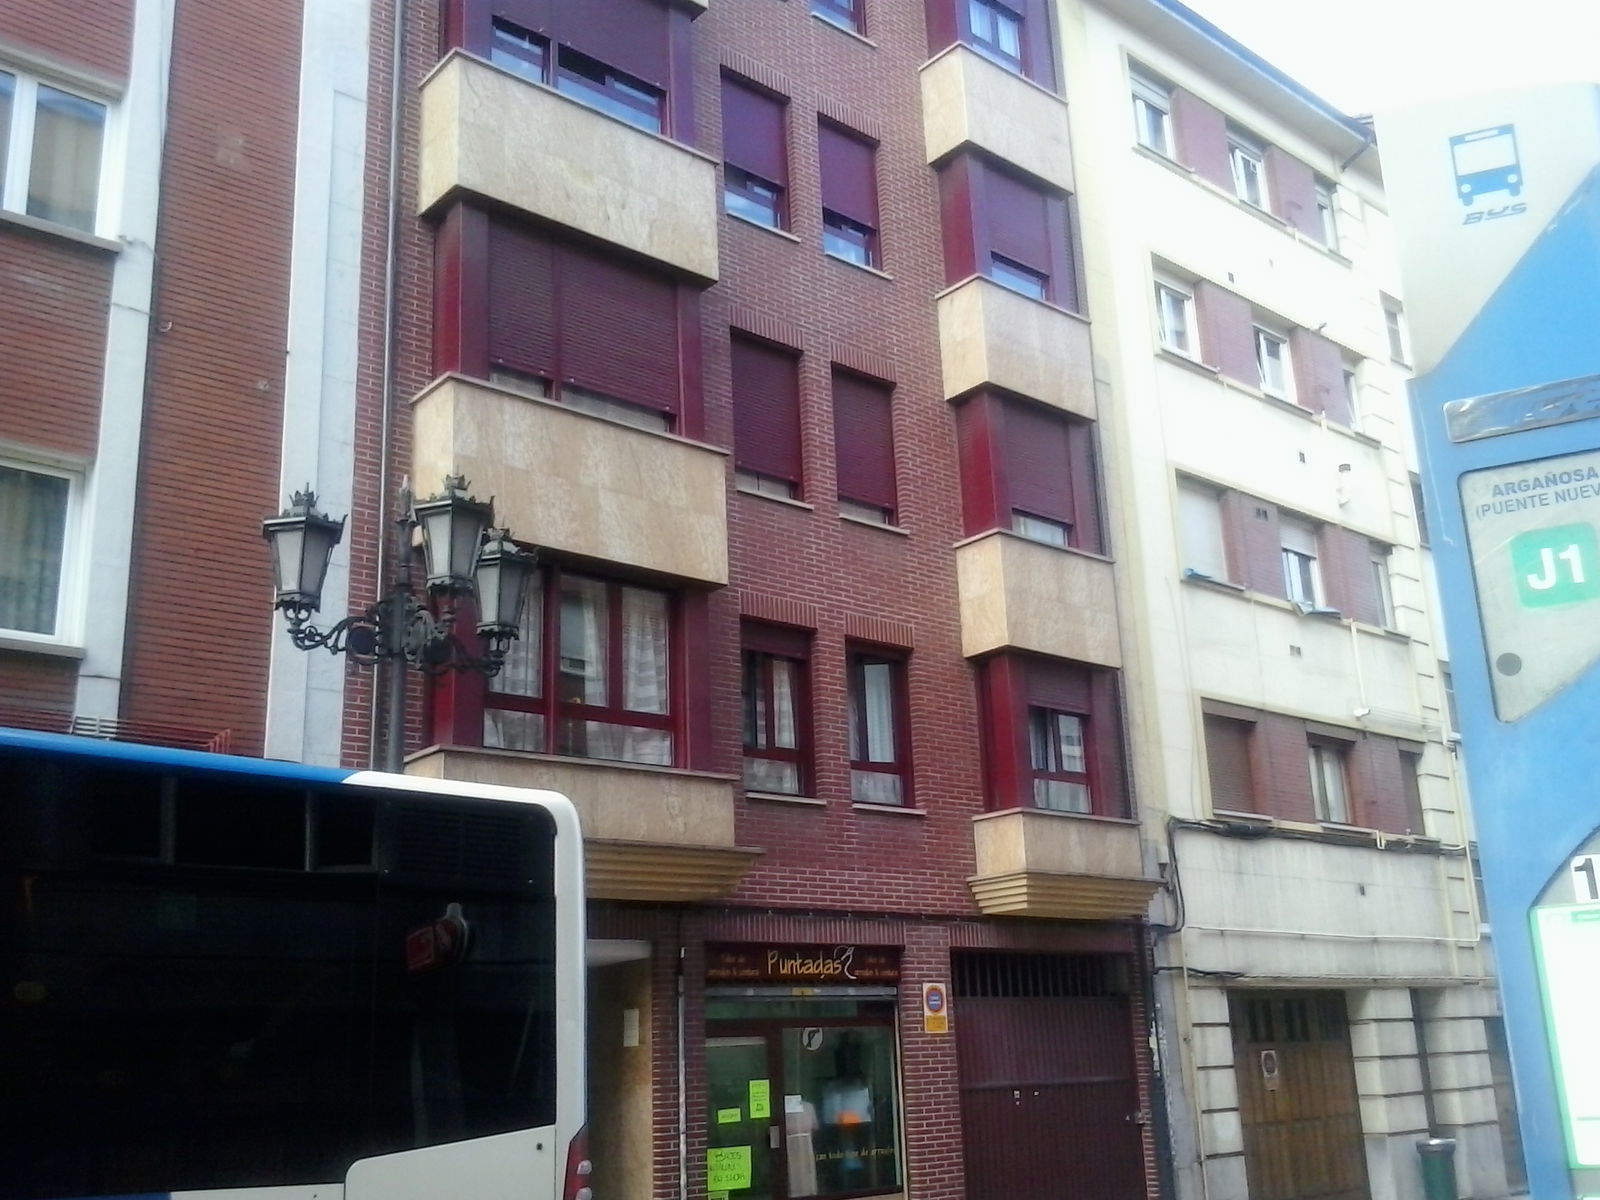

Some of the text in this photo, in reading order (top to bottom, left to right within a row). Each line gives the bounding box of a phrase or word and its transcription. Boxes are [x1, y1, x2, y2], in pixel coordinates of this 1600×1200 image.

[1462, 202, 1528, 225] BUS
[1476, 492, 1550, 521] (PUENTE
[1527, 543, 1585, 590] J1
[767, 949, 842, 977] Puntadas
